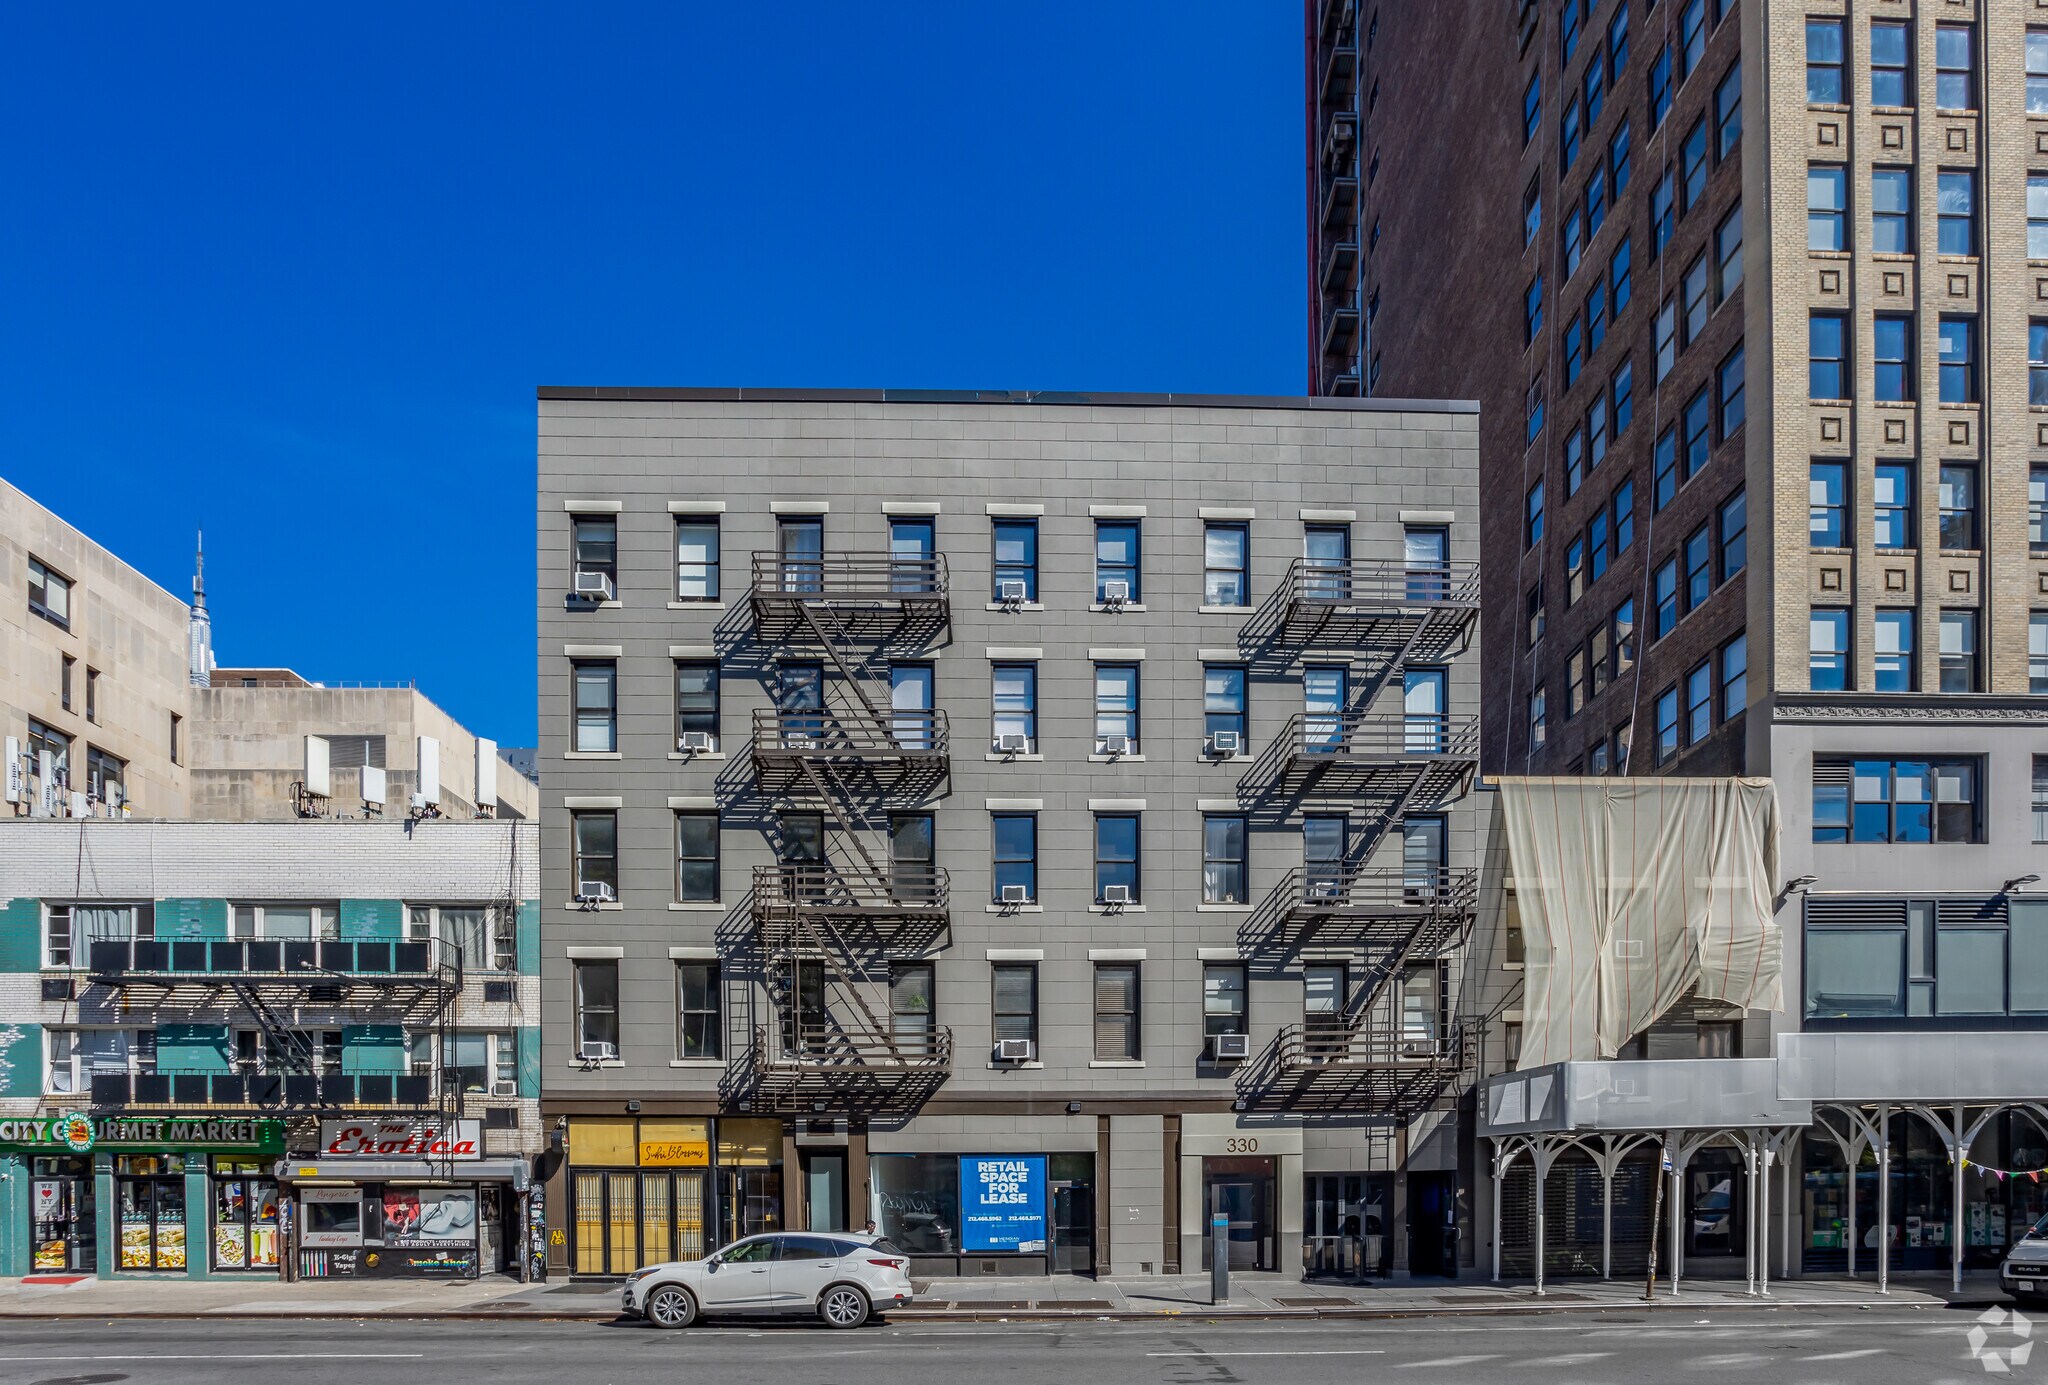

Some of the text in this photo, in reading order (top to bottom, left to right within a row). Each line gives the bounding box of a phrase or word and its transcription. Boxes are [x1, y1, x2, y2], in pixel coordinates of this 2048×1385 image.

[0, 1121, 47, 1141] CITY
[170, 1121, 258, 1140] MARKET
[69, 1113, 95, 1137] GOURMET
[379, 1125, 406, 1133] THE
[68, 1140, 92, 1152] MARKET
[328, 1127, 477, 1155] Erotica
[1226, 1137, 1258, 1153] 330
[666, 1145, 706, 1161] Blossoms
[978, 1161, 1030, 1172] RETAIL
[980, 1172, 1028, 1183] SPACE
[988, 1182, 1019, 1194] FOR
[314, 1190, 349, 1200] Lingerie
[980, 1193, 1028, 1205] LEASE
[443, 1258, 469, 1269] Shop
